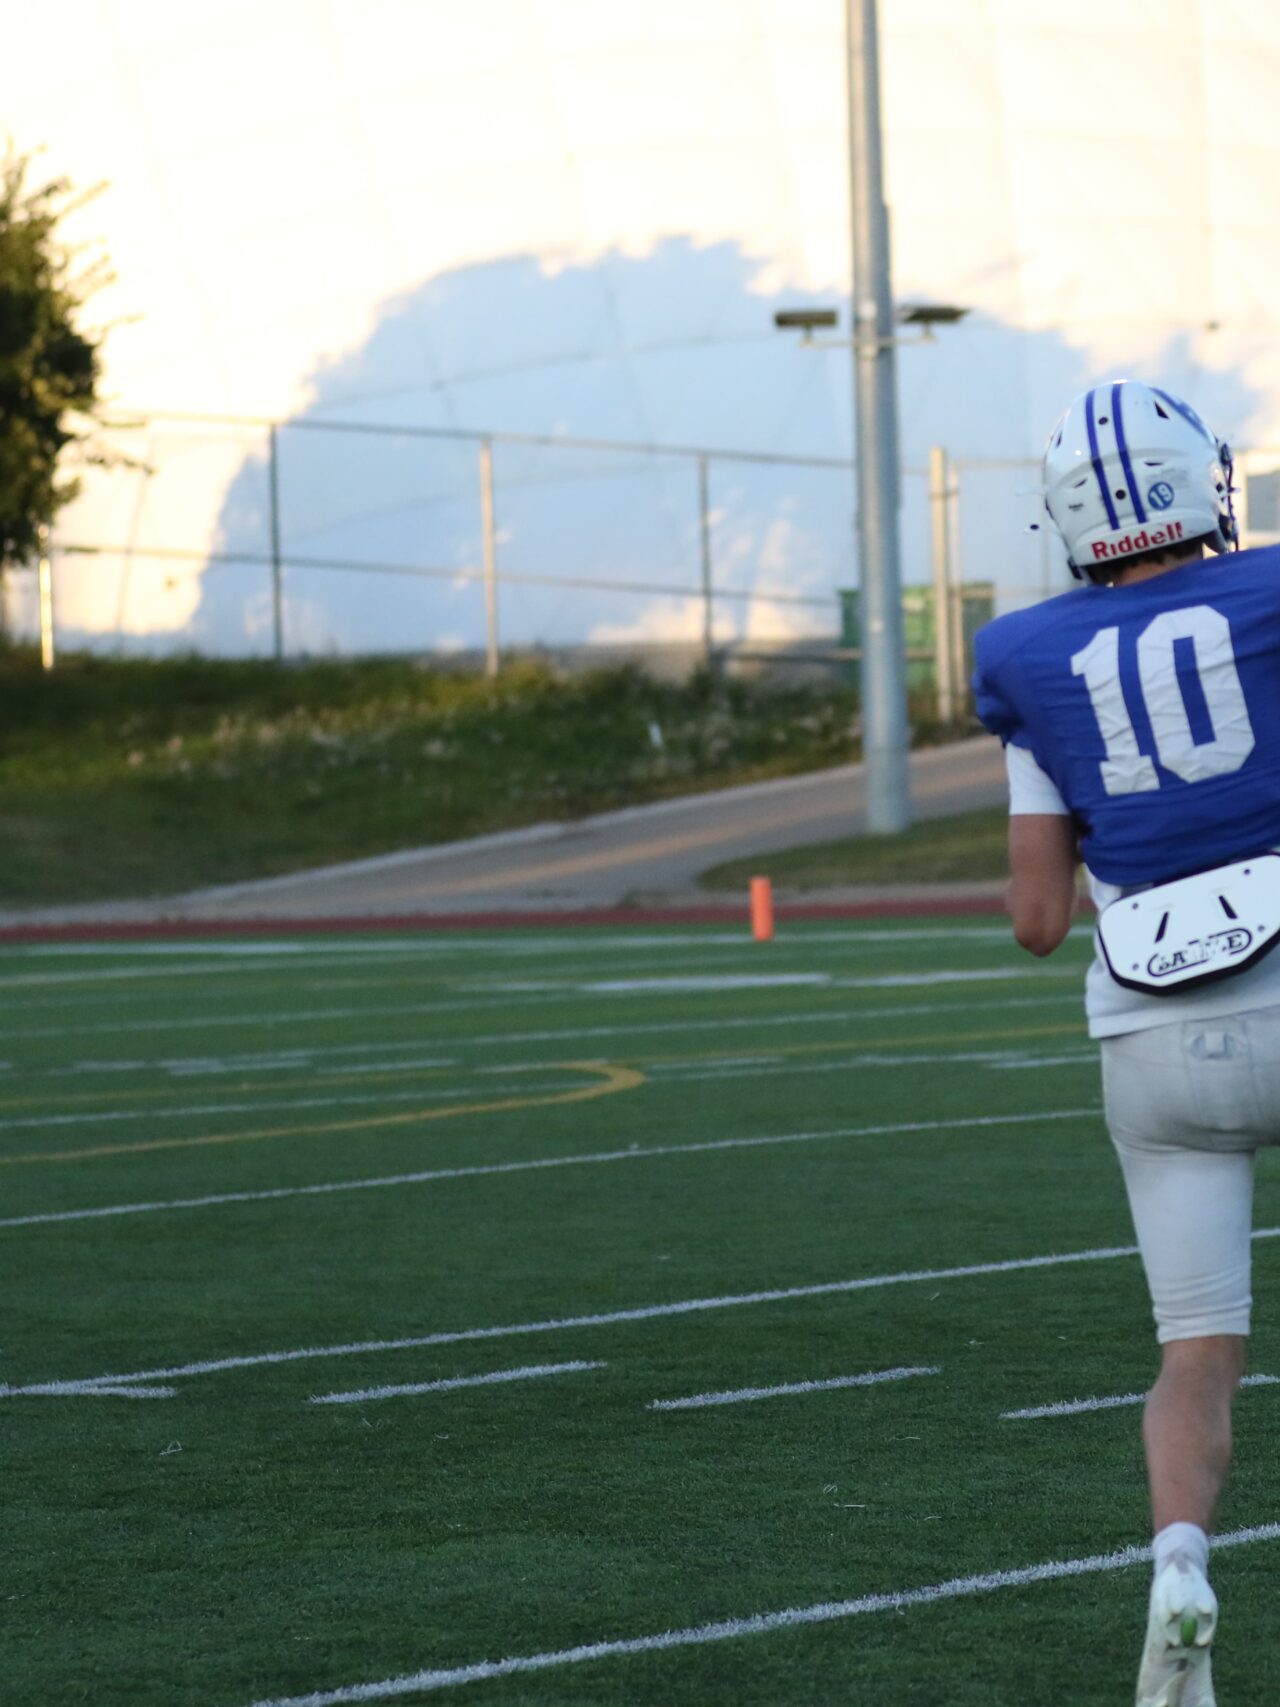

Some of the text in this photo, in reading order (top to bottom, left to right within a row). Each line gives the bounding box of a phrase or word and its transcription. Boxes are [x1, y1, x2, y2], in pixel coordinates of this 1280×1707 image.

[1151, 485, 1171, 507] 19
[1092, 522, 1182, 559] Riddell
[1071, 605, 1254, 795] 10
